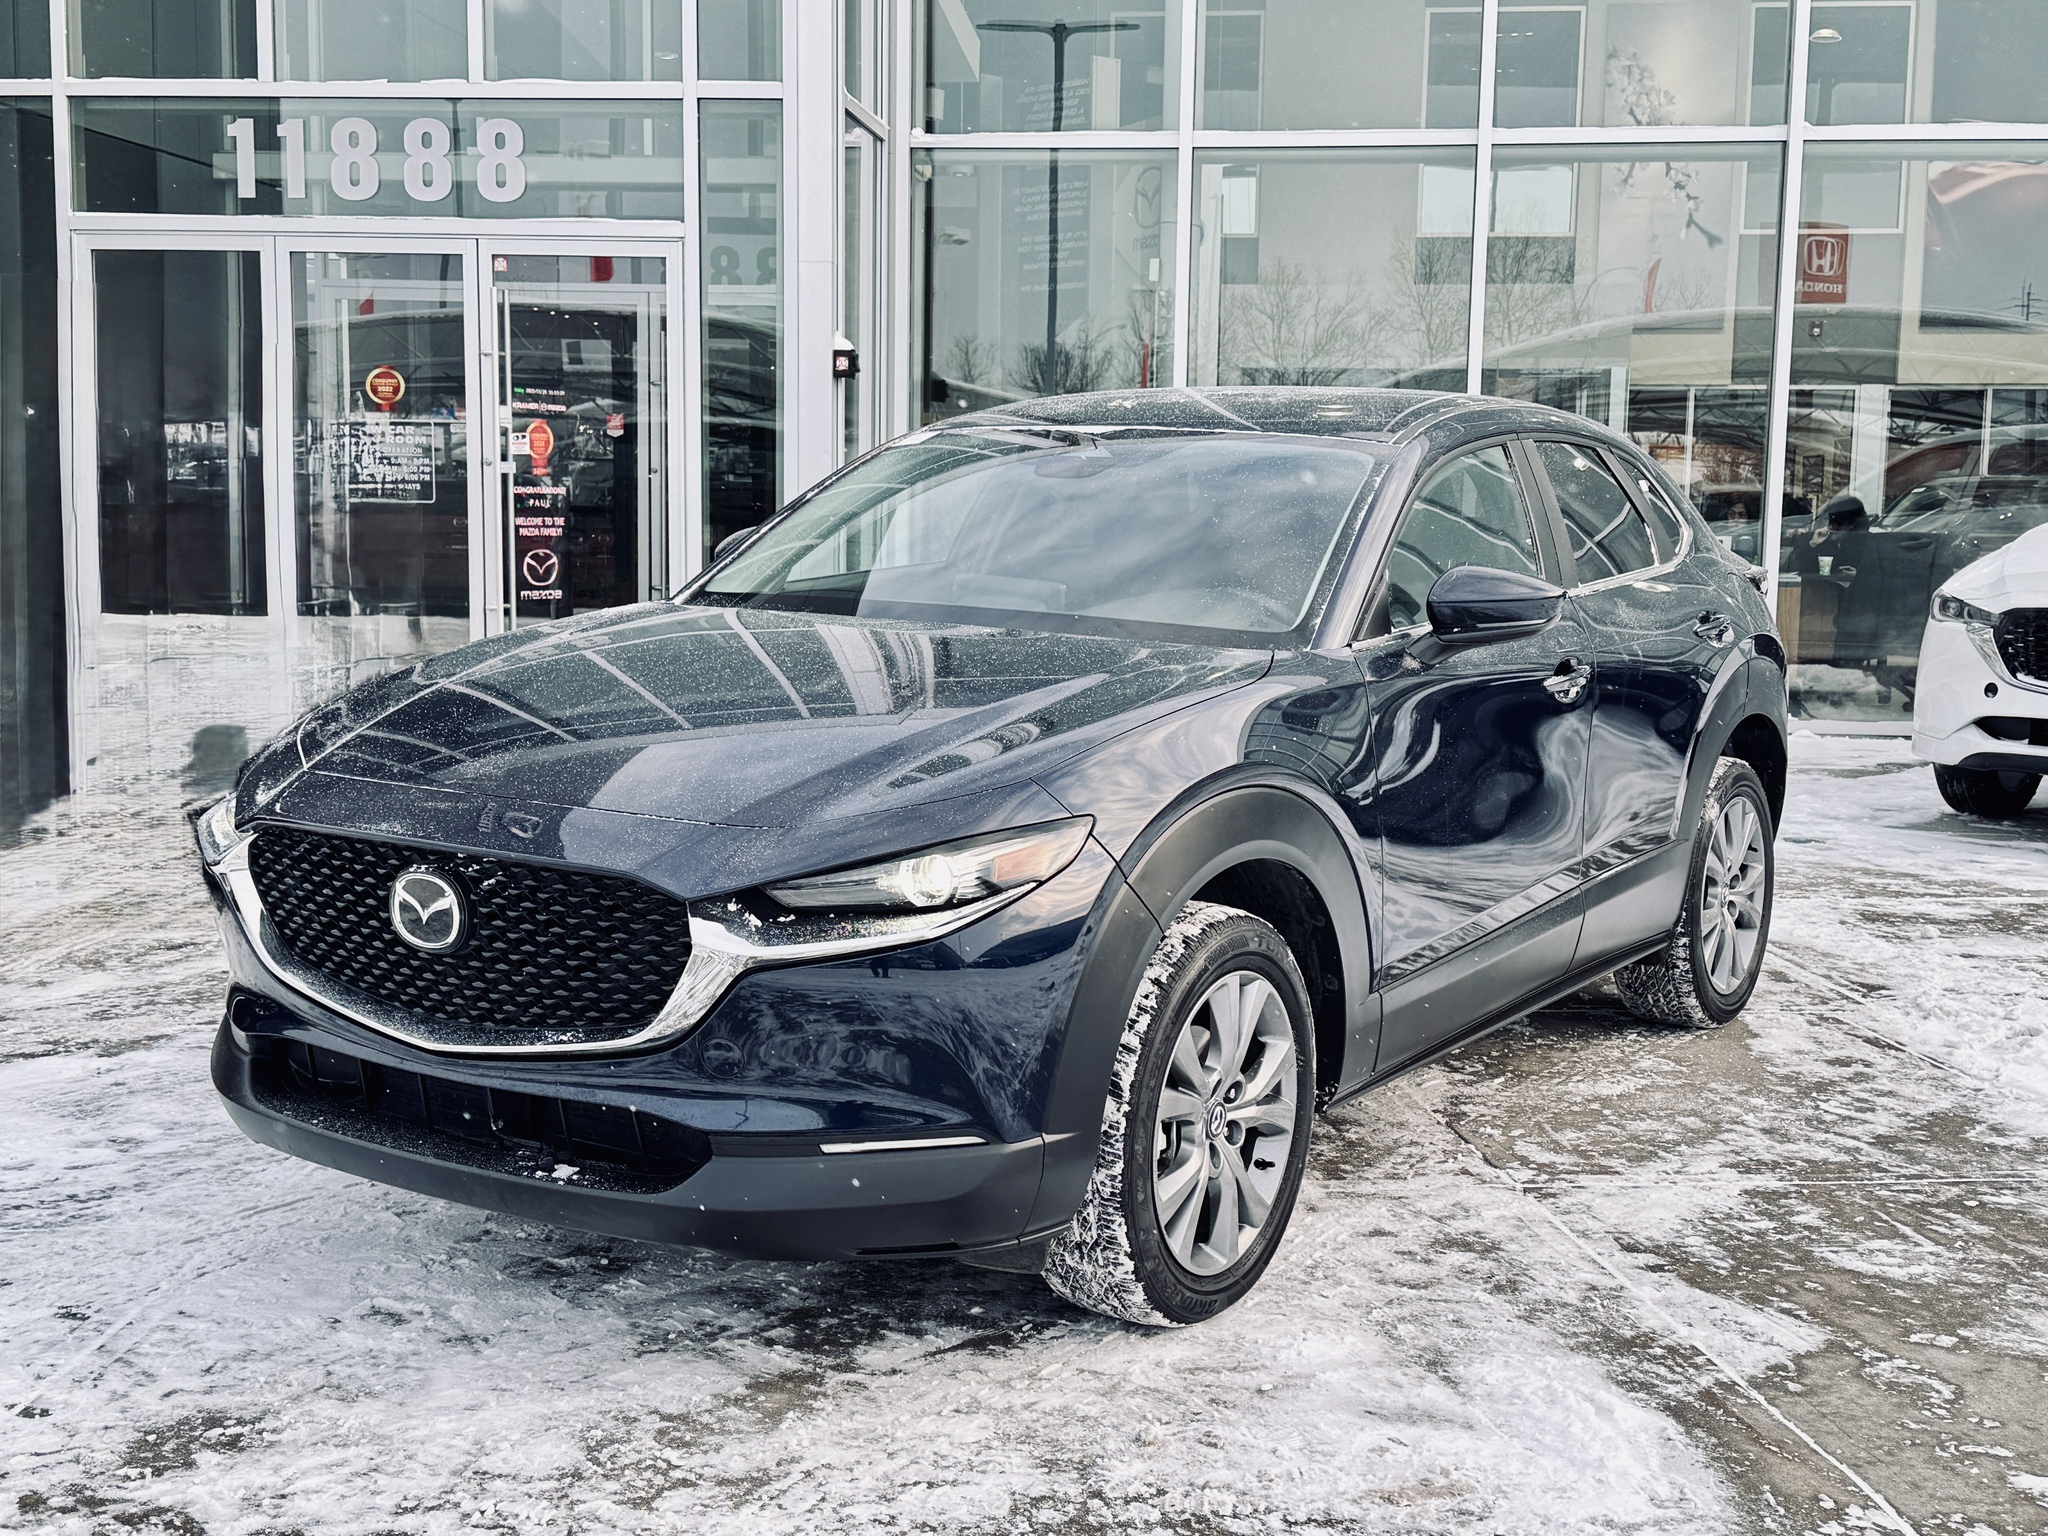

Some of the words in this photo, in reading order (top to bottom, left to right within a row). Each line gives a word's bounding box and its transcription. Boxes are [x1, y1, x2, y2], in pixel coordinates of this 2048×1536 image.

[227, 117, 526, 203] 11888
[391, 425, 415, 434] CAR
[515, 517, 543, 526] WELCOME
[544, 517, 553, 526] TO
[553, 517, 565, 526] THE
[519, 528, 540, 537] MAZDA
[521, 590, 562, 600] mazda
